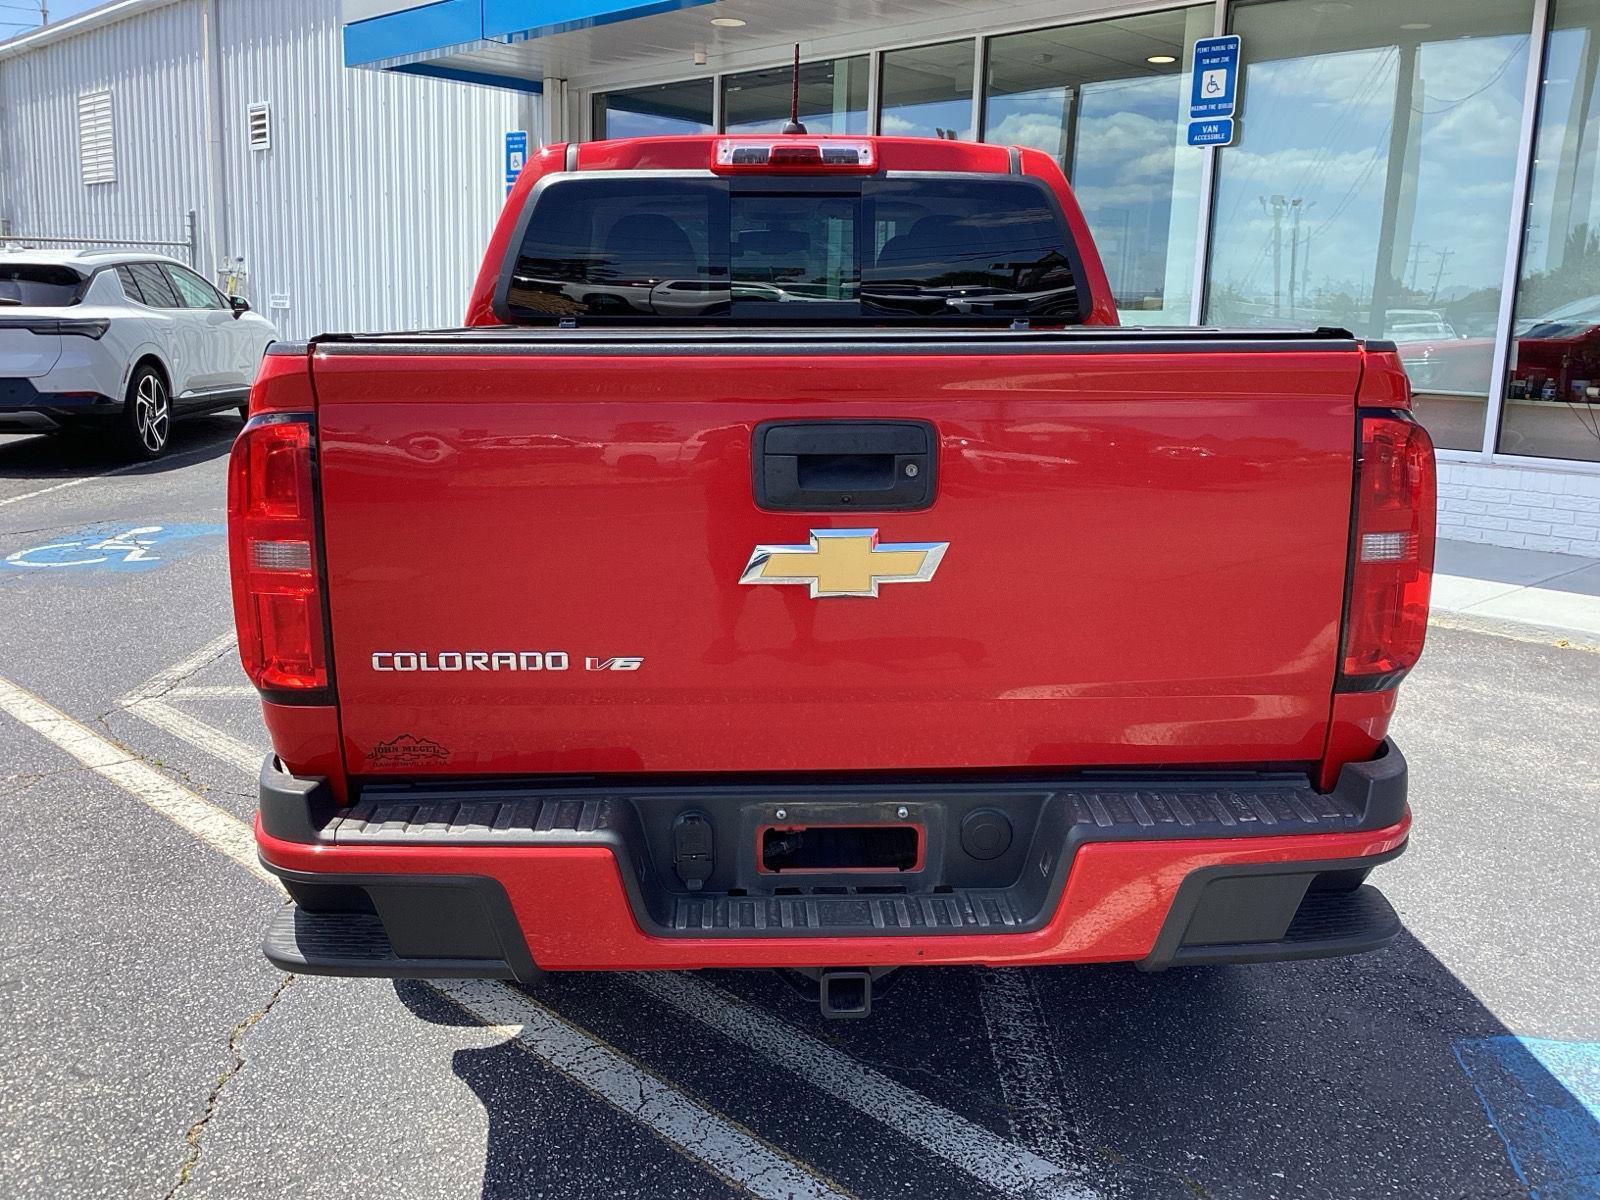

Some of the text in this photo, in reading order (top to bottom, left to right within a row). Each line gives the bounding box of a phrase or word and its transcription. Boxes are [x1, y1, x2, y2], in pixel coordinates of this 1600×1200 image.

[1202, 124, 1218, 133] VAN
[1193, 132, 1225, 141] ACCESSIBLE
[372, 651, 645, 671] COLORADO V6
[373, 745, 439, 757] JOHN MEGEL
